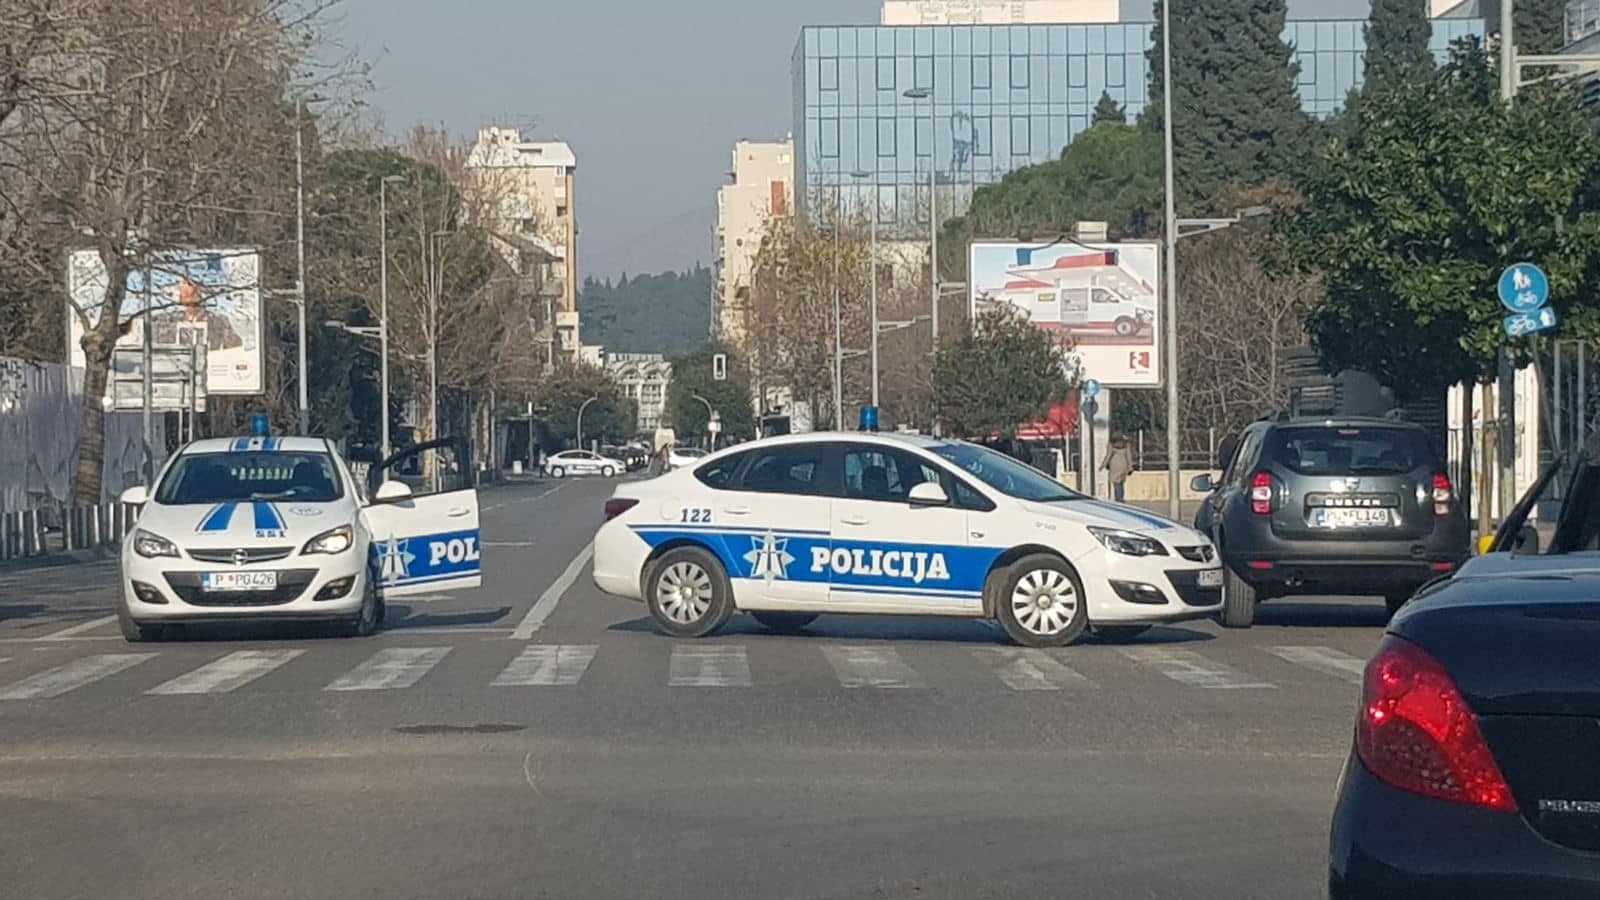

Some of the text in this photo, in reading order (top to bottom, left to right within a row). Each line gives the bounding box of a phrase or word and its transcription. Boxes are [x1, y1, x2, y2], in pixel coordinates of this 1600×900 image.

[681, 508, 711, 523] 122
[429, 536, 481, 567] POL
[810, 546, 951, 584] POLICIJA
